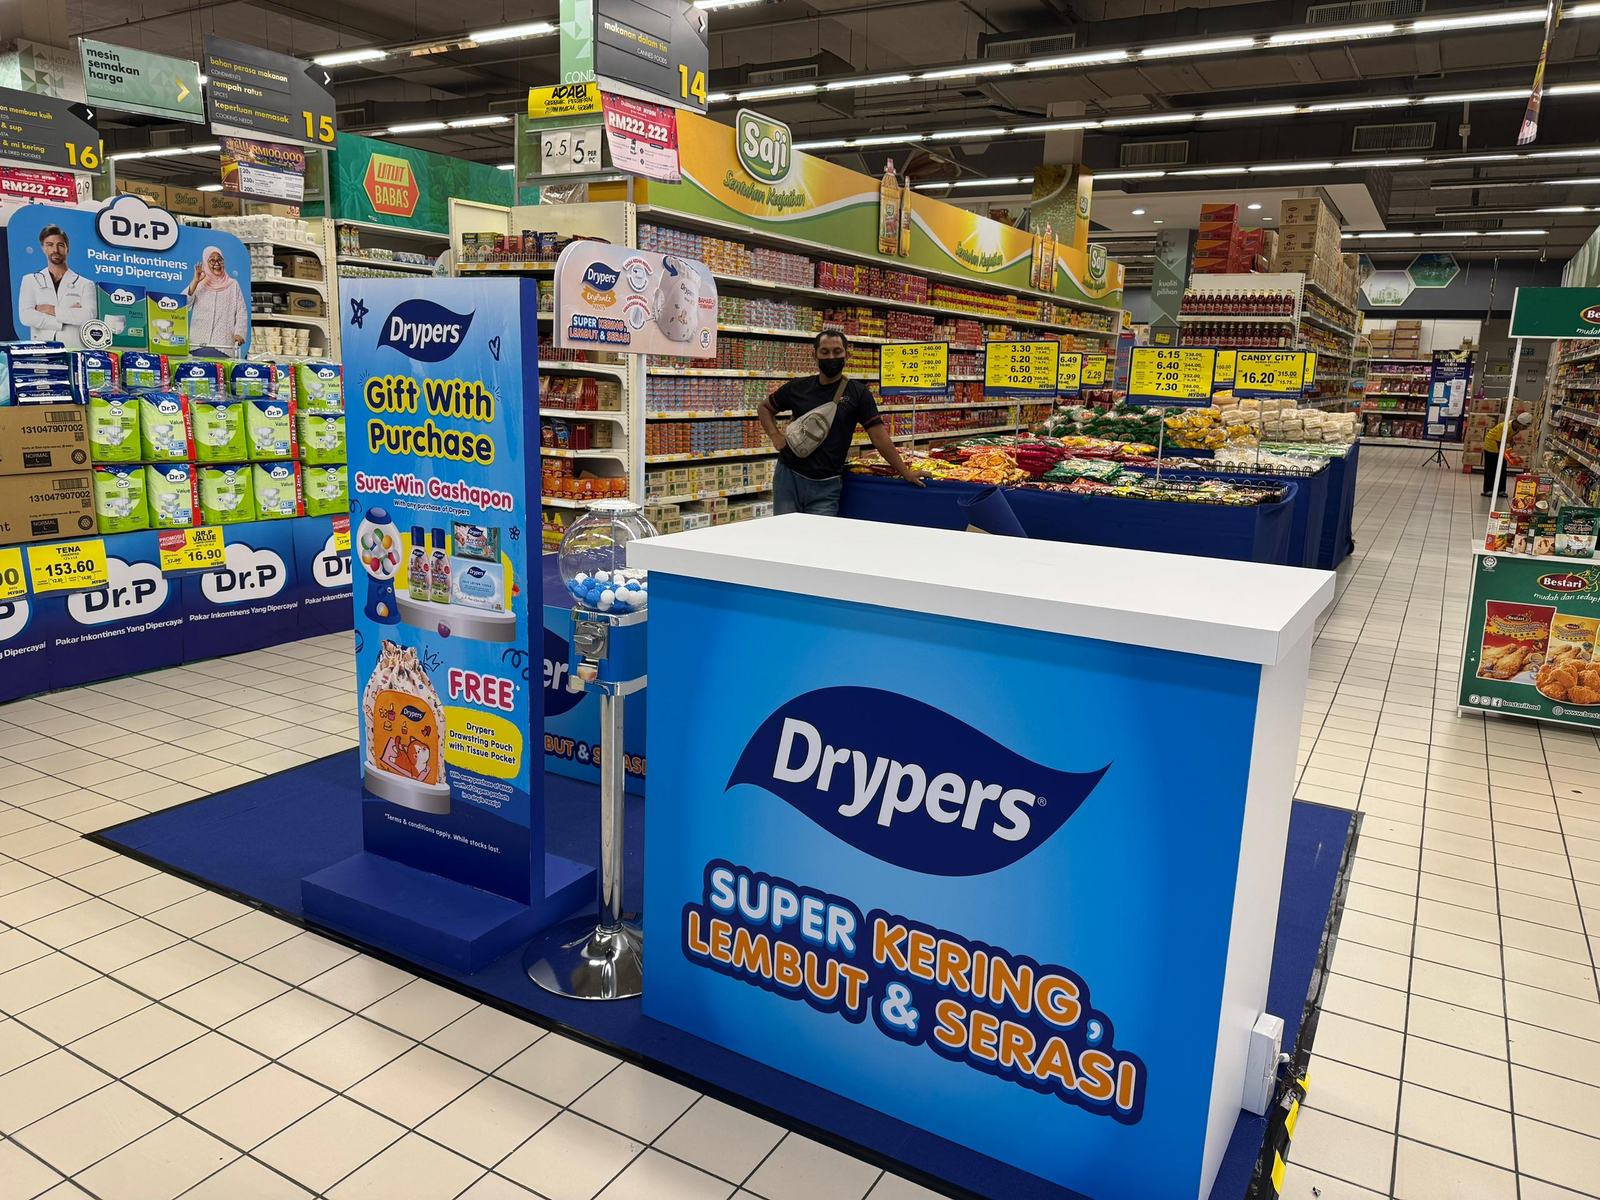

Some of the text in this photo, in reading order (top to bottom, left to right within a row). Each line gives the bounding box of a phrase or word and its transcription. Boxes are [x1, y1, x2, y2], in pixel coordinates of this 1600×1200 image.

[604, 22, 668, 53] makanan dalam tin
[86, 48, 120, 62] mesin
[88, 59, 140, 76] semakan
[89, 67, 124, 85] harga
[210, 57, 288, 83] bahan perasa makanan
[213, 80, 263, 97] rempah ratus
[552, 85, 587, 99] ADABI
[678, 63, 706, 104] 14
[9, 107, 38, 117] membuat
[214, 99, 289, 124] keperluan memasak
[9, 124, 22, 132] sup
[302, 111, 335, 143] 15
[608, 111, 668, 142] RM222,222
[22, 142, 45, 153] kering
[65, 142, 99, 169] 16
[744, 121, 788, 176] Saji
[2, 180, 69, 197] RM222,222
[110, 215, 170, 241] Dr.P
[87, 249, 188, 270] Pakar Inkontinens
[94, 264, 183, 281] yang Dipercayai
[587, 268, 616, 284] Drypers
[113, 294, 133, 303] Dr.P
[1156, 288, 1178, 296] pilihan
[160, 301, 177, 309] Dr.P
[573, 316, 597, 328] SUPER
[390, 316, 461, 349] Drypers
[600, 332, 606, 341] &
[1087, 371, 1102, 379] 2.29
[1242, 372, 1274, 383] 16.20
[1156, 383, 1177, 391] 7.30
[366, 378, 492, 418] Gift With
[22, 424, 84, 434] 131047907002
[370, 422, 492, 461] Purchase
[29, 491, 91, 503] 131047907002
[356, 473, 513, 510] Sure-Win Gashapon
[417, 504, 440, 512] purchase
[449, 507, 470, 516] Drypers
[56, 546, 81, 554] TENA
[188, 549, 221, 561] 16.90
[45, 560, 94, 576] 153.60
[213, 564, 277, 592] Dr.P
[1543, 577, 1582, 588] Bestari
[82, 578, 156, 613] Dr.P
[305, 596, 322, 605] Pakar
[1534, 592, 1559, 601] mudah
[189, 601, 298, 621] Pakar Inkontinens Yang Dipercayai
[55, 616, 183, 646] Pakar Inkontinens Yang Dipercayai
[4, 641, 46, 658] Dipercayai
[404, 709, 423, 719] Drypers
[1503, 700, 1541, 711] bestarifood
[466, 722, 495, 736] Drypers
[449, 730, 513, 752] Drawstring Pouch
[449, 741, 516, 765] with Tissue Pocket
[578, 743, 590, 760] &
[773, 717, 1036, 842] Drypers
[408, 820, 435, 834] conditions
[453, 833, 469, 844] While
[469, 839, 487, 850] stocks
[488, 844, 501, 854] last.
[711, 867, 856, 952] SUPER
[687, 909, 1137, 1111] LEMBUT & SERASI
